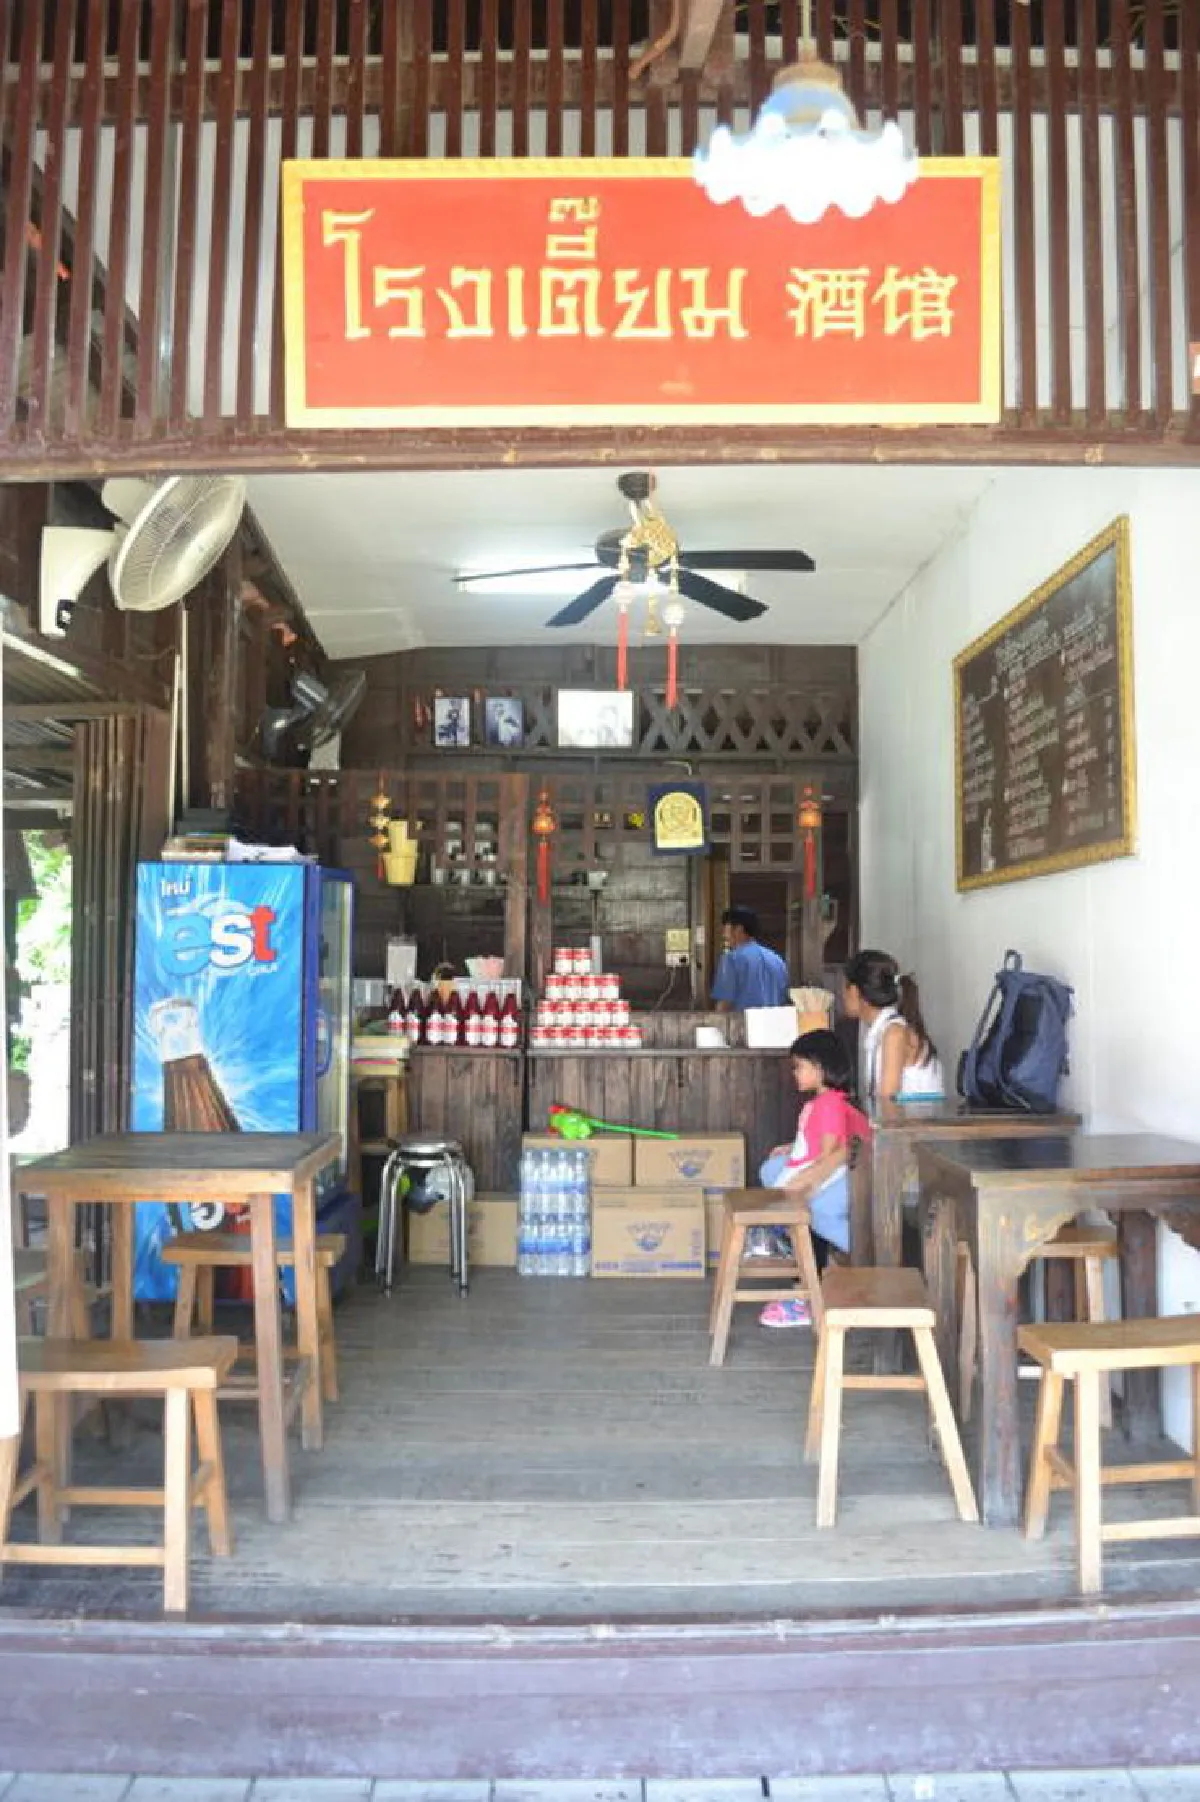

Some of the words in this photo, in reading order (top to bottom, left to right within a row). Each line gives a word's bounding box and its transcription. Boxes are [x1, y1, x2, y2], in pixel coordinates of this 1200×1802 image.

[322, 196, 748, 339] โรงเตี๊ยม
[786, 266, 957, 340] 酒馆
[160, 904, 277, 976] est
